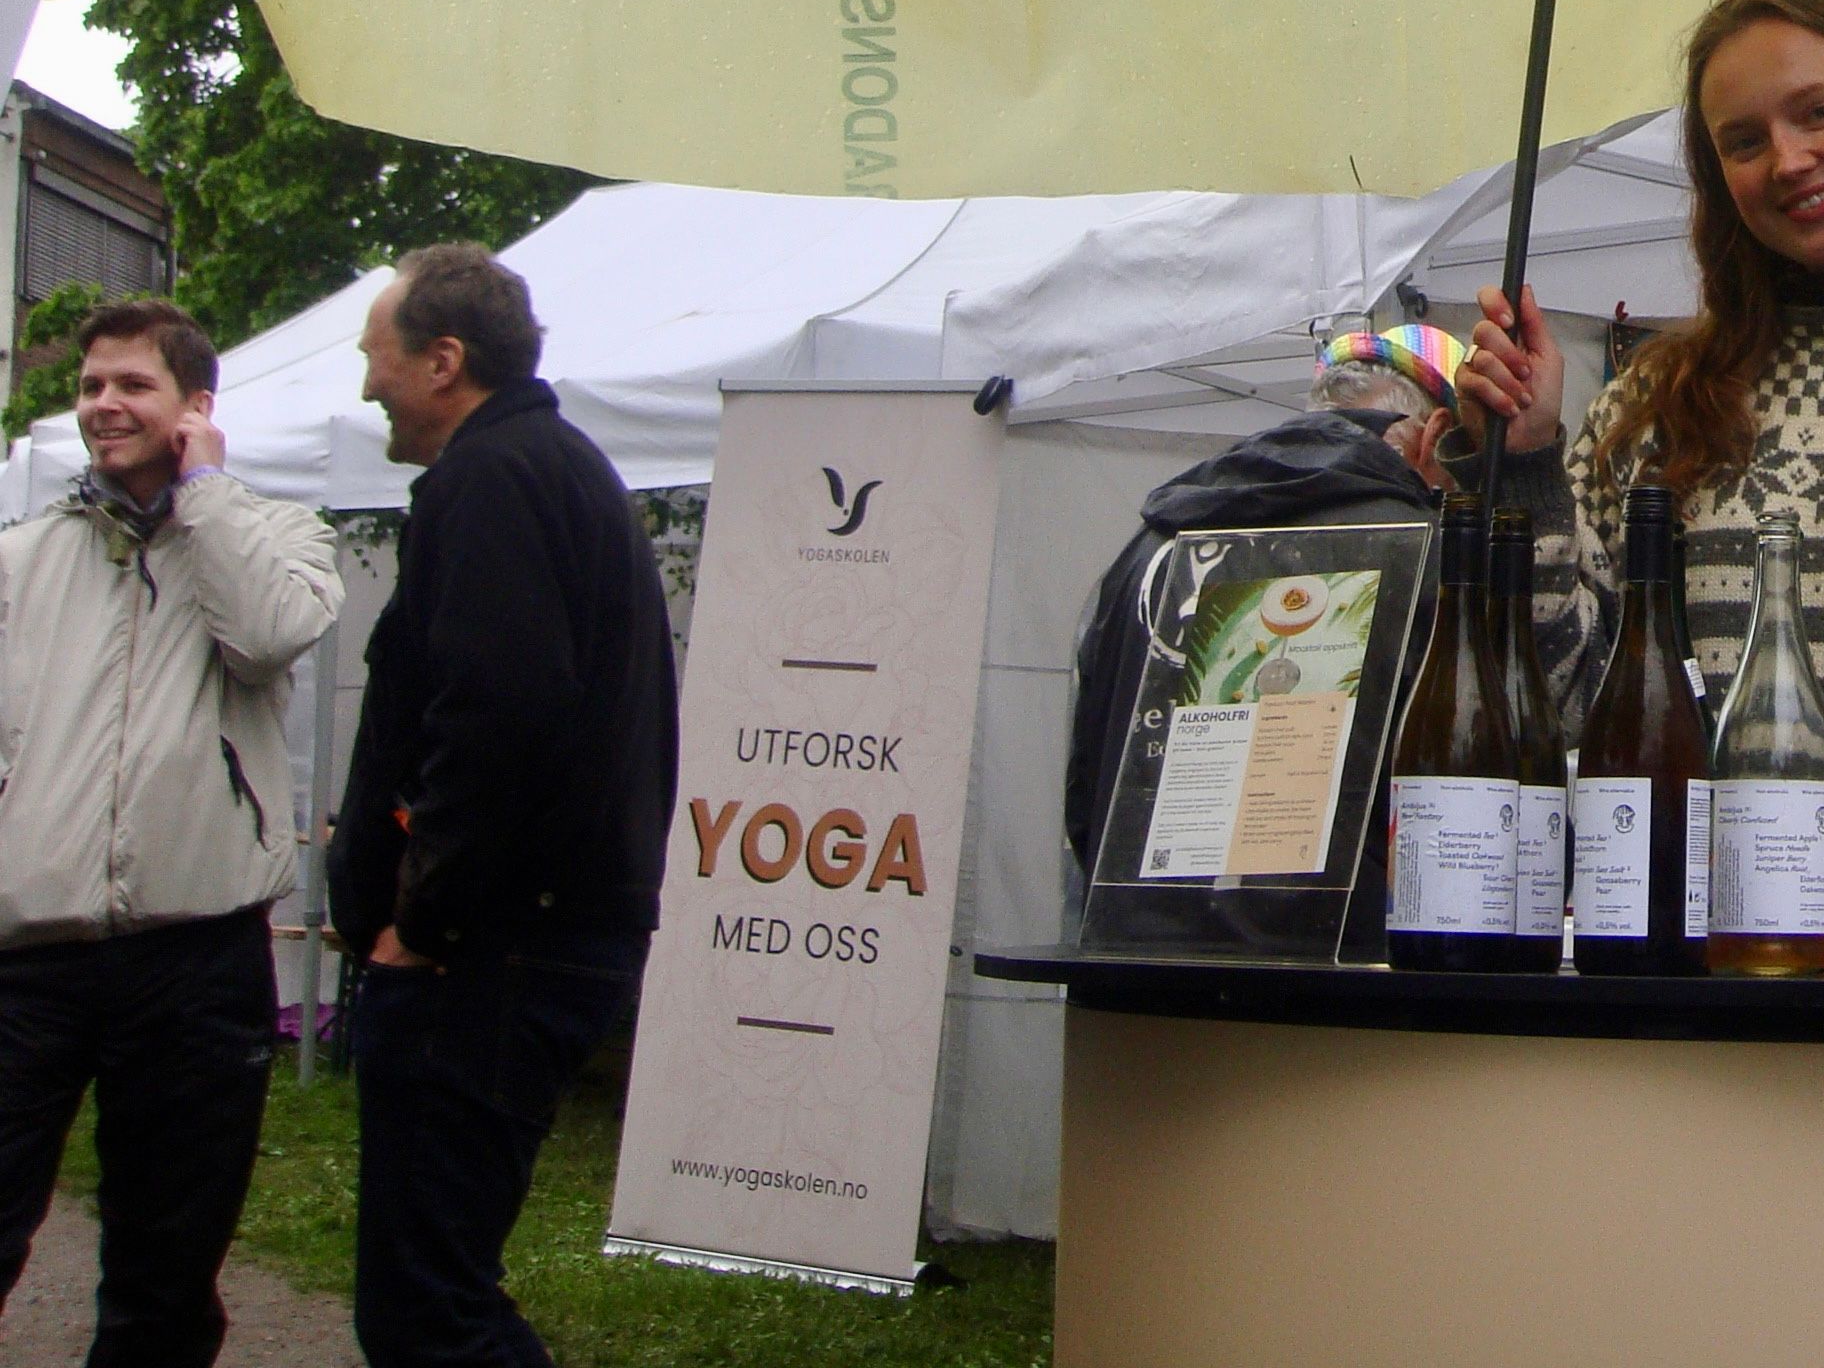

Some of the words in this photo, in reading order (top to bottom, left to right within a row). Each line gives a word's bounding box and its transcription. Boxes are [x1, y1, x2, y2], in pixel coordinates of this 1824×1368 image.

[798, 547, 890, 564] YOGASKOLEN
[1177, 725, 1210, 737] norge
[1179, 710, 1250, 724] ALKOHOLFRI
[737, 728, 903, 772] UTFORSK
[689, 797, 928, 896] YOGA
[1755, 834, 1798, 842] Fermented
[713, 914, 791, 955] MED
[805, 922, 880, 964] OSS
[672, 1158, 868, 1199] www.yogaskolen.no
